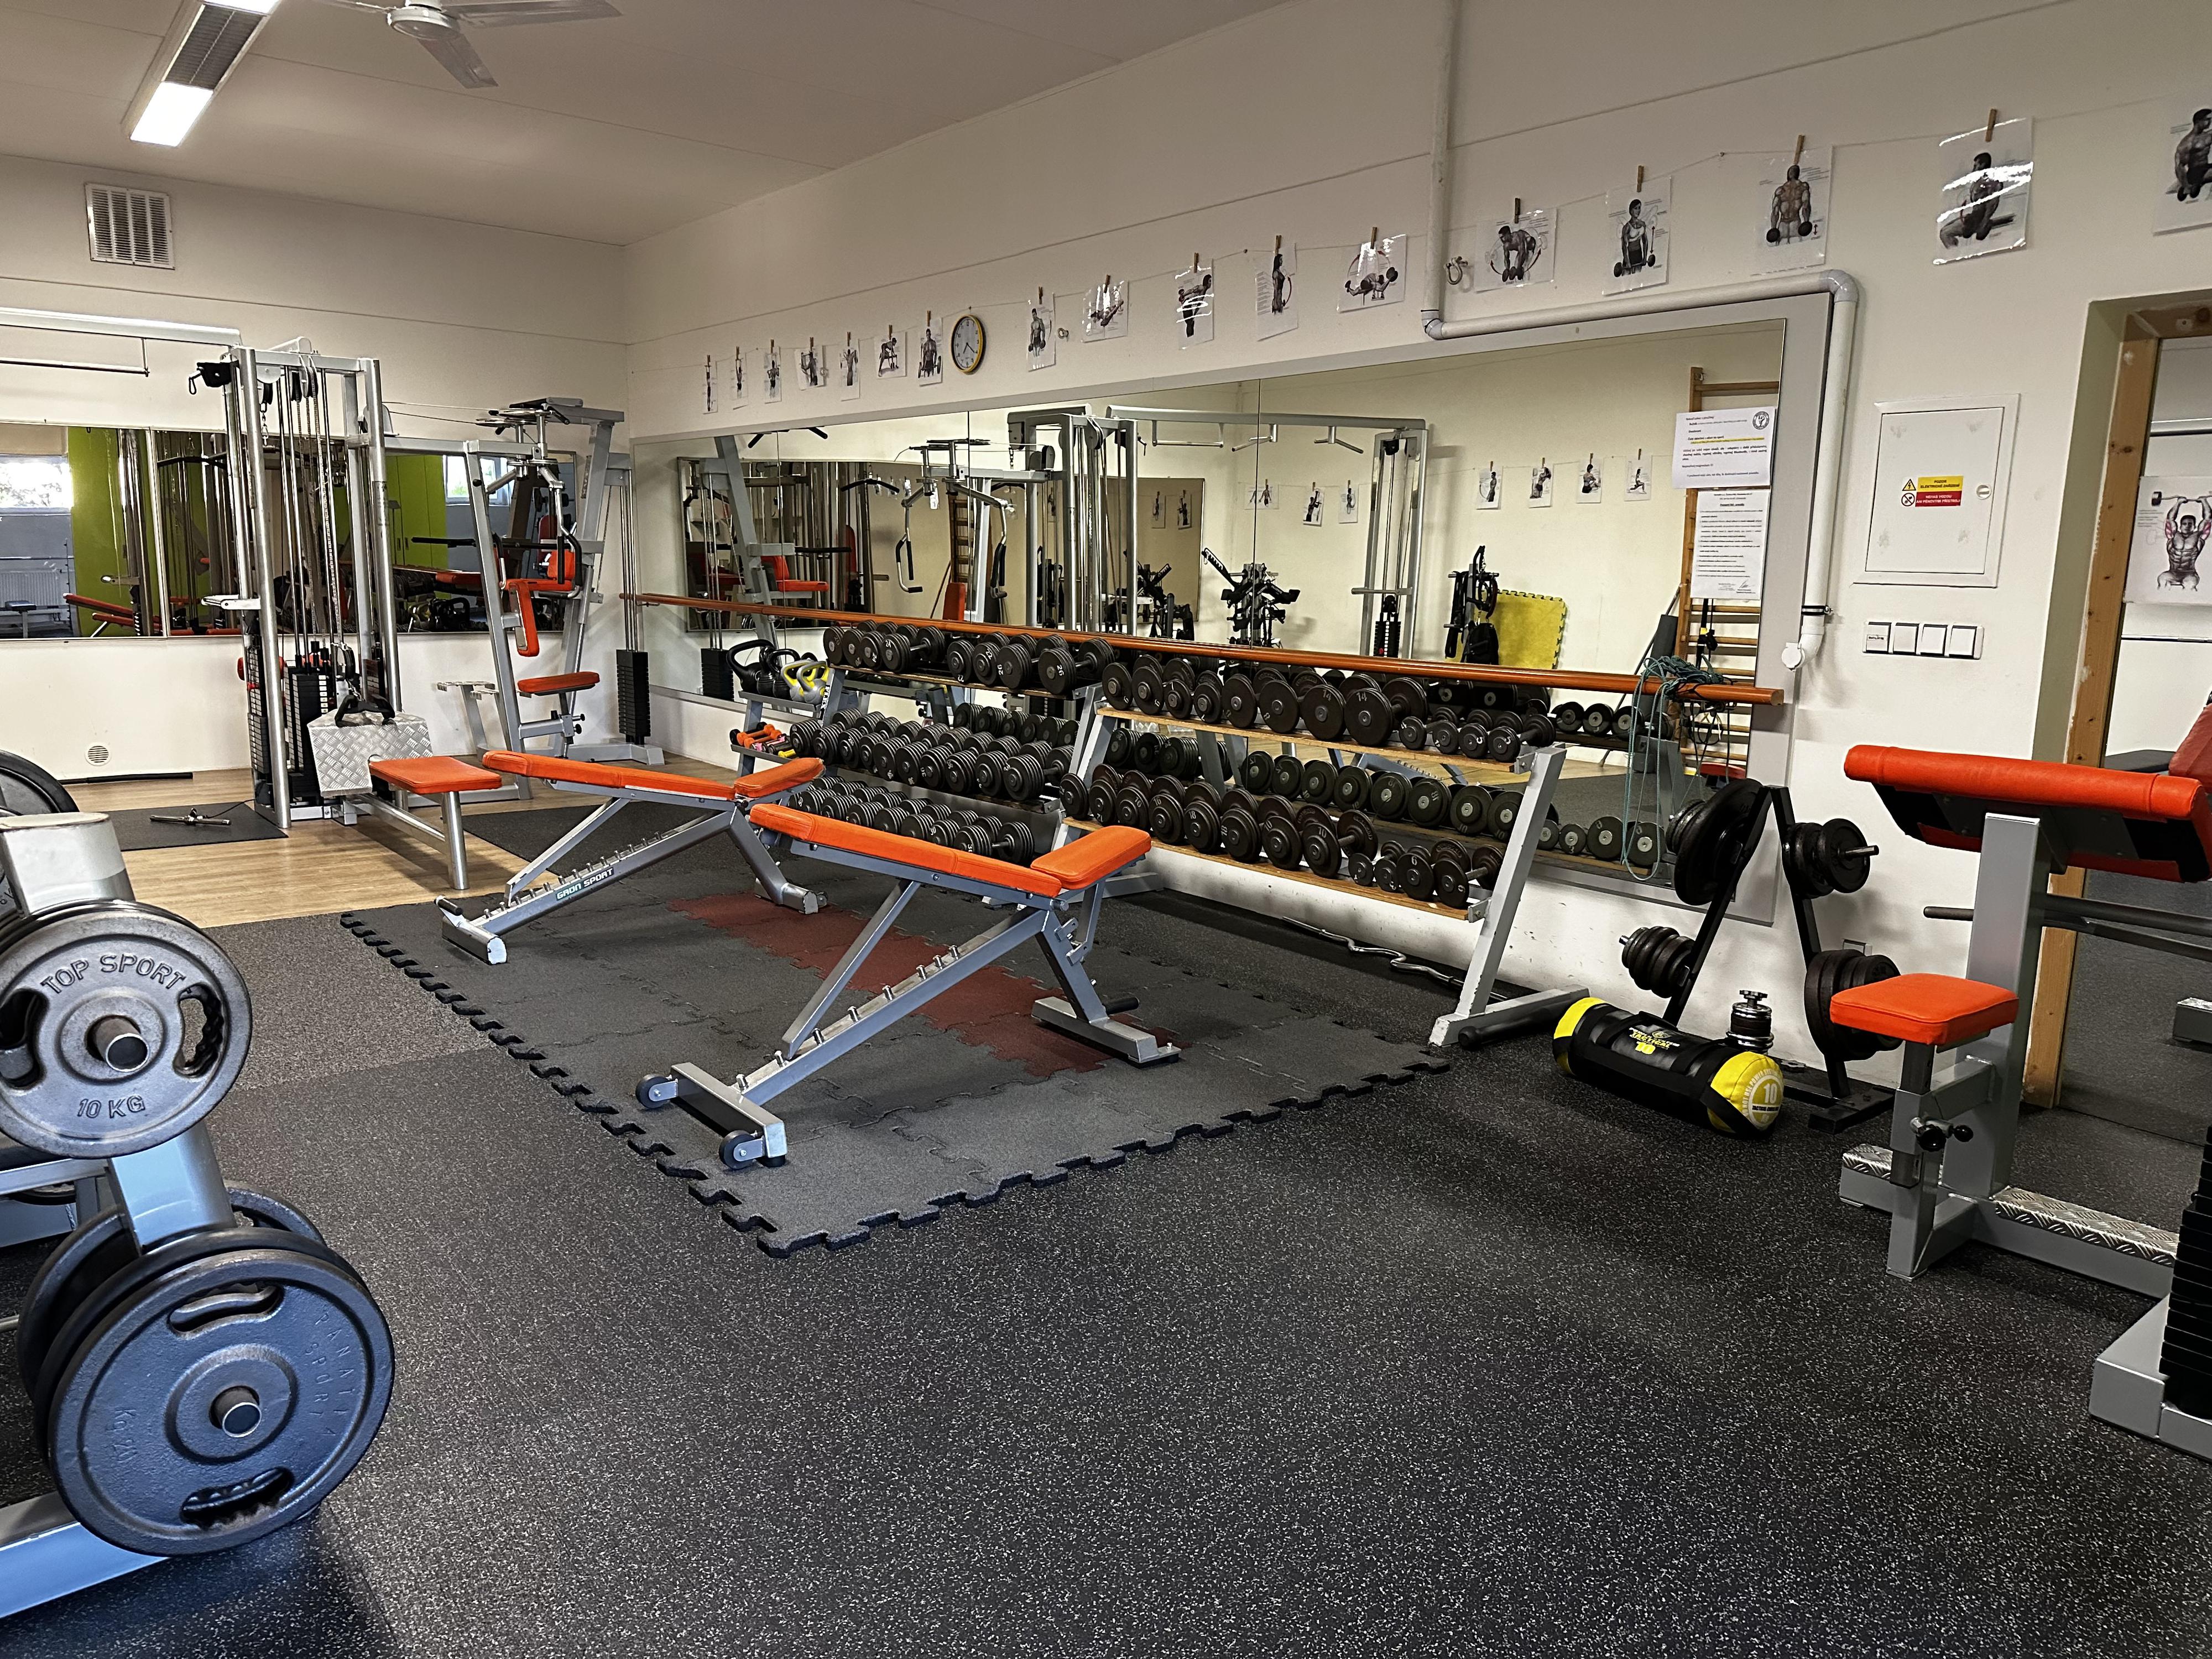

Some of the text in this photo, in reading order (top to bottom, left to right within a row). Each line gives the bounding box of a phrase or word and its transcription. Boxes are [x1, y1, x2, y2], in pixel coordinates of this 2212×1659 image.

[872, 653, 878, 663] 24
[985, 649, 993, 660] 22
[997, 664, 1004, 676] 26
[1057, 665, 1065, 676] 26
[1323, 689, 1332, 701] 14
[1357, 692, 1368, 702] 14
[1134, 796, 1141, 808] 16
[1154, 797, 1161, 806] 16
[1189, 810, 1197, 820] 18
[1221, 825, 1228, 836] 18
[1264, 820, 1272, 830] 10
[930, 826, 937, 836] 30
[1318, 826, 1327, 838] 10
[583, 868, 613, 887] SPORT
[40, 953, 187, 995] TOP SPORT
[1635, 1041, 1656, 1055] 10
[1764, 1083, 1778, 1104] 10
[77, 1095, 146, 1119] 10 KG
